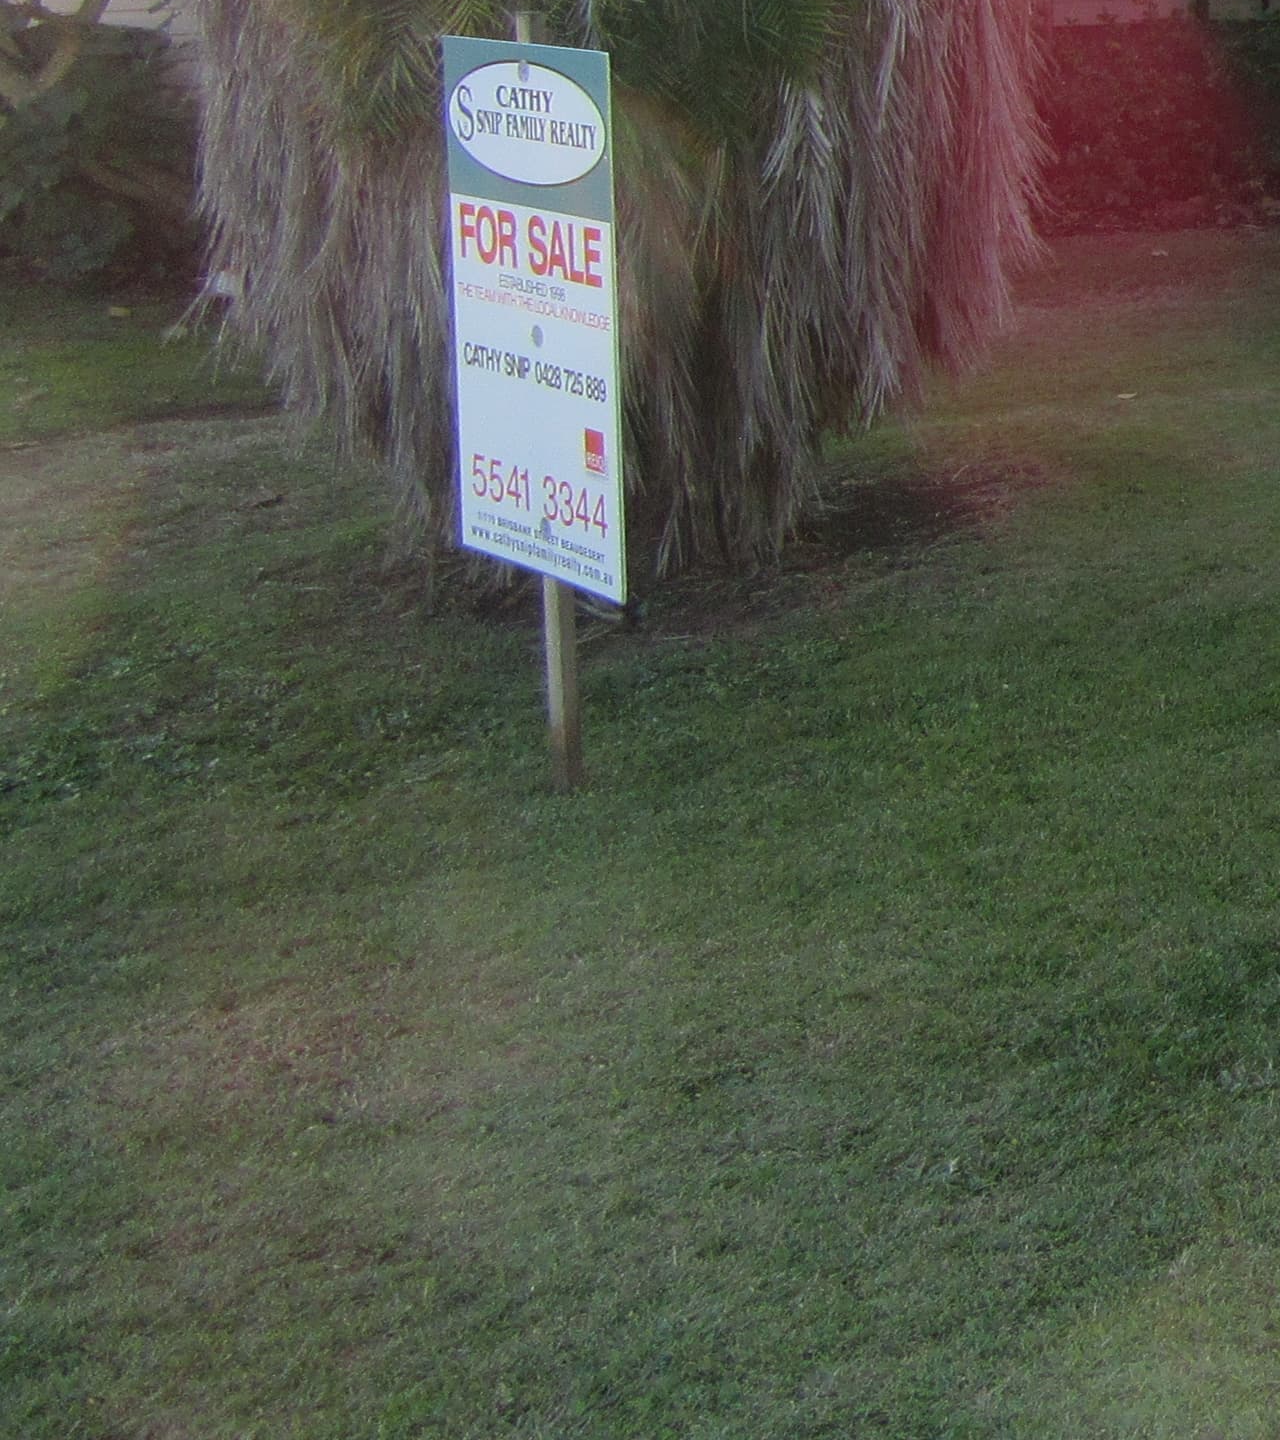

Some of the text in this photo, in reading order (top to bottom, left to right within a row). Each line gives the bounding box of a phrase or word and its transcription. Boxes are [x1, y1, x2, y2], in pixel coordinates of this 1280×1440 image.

[496, 85, 553, 113] CATHY
[477, 109, 597, 150] SNIP FAMILY REALTY
[459, 202, 602, 288] FOR SALE
[464, 342, 607, 402] CATHY SNIP 0428 725 889
[472, 454, 608, 539] 5541 3344
